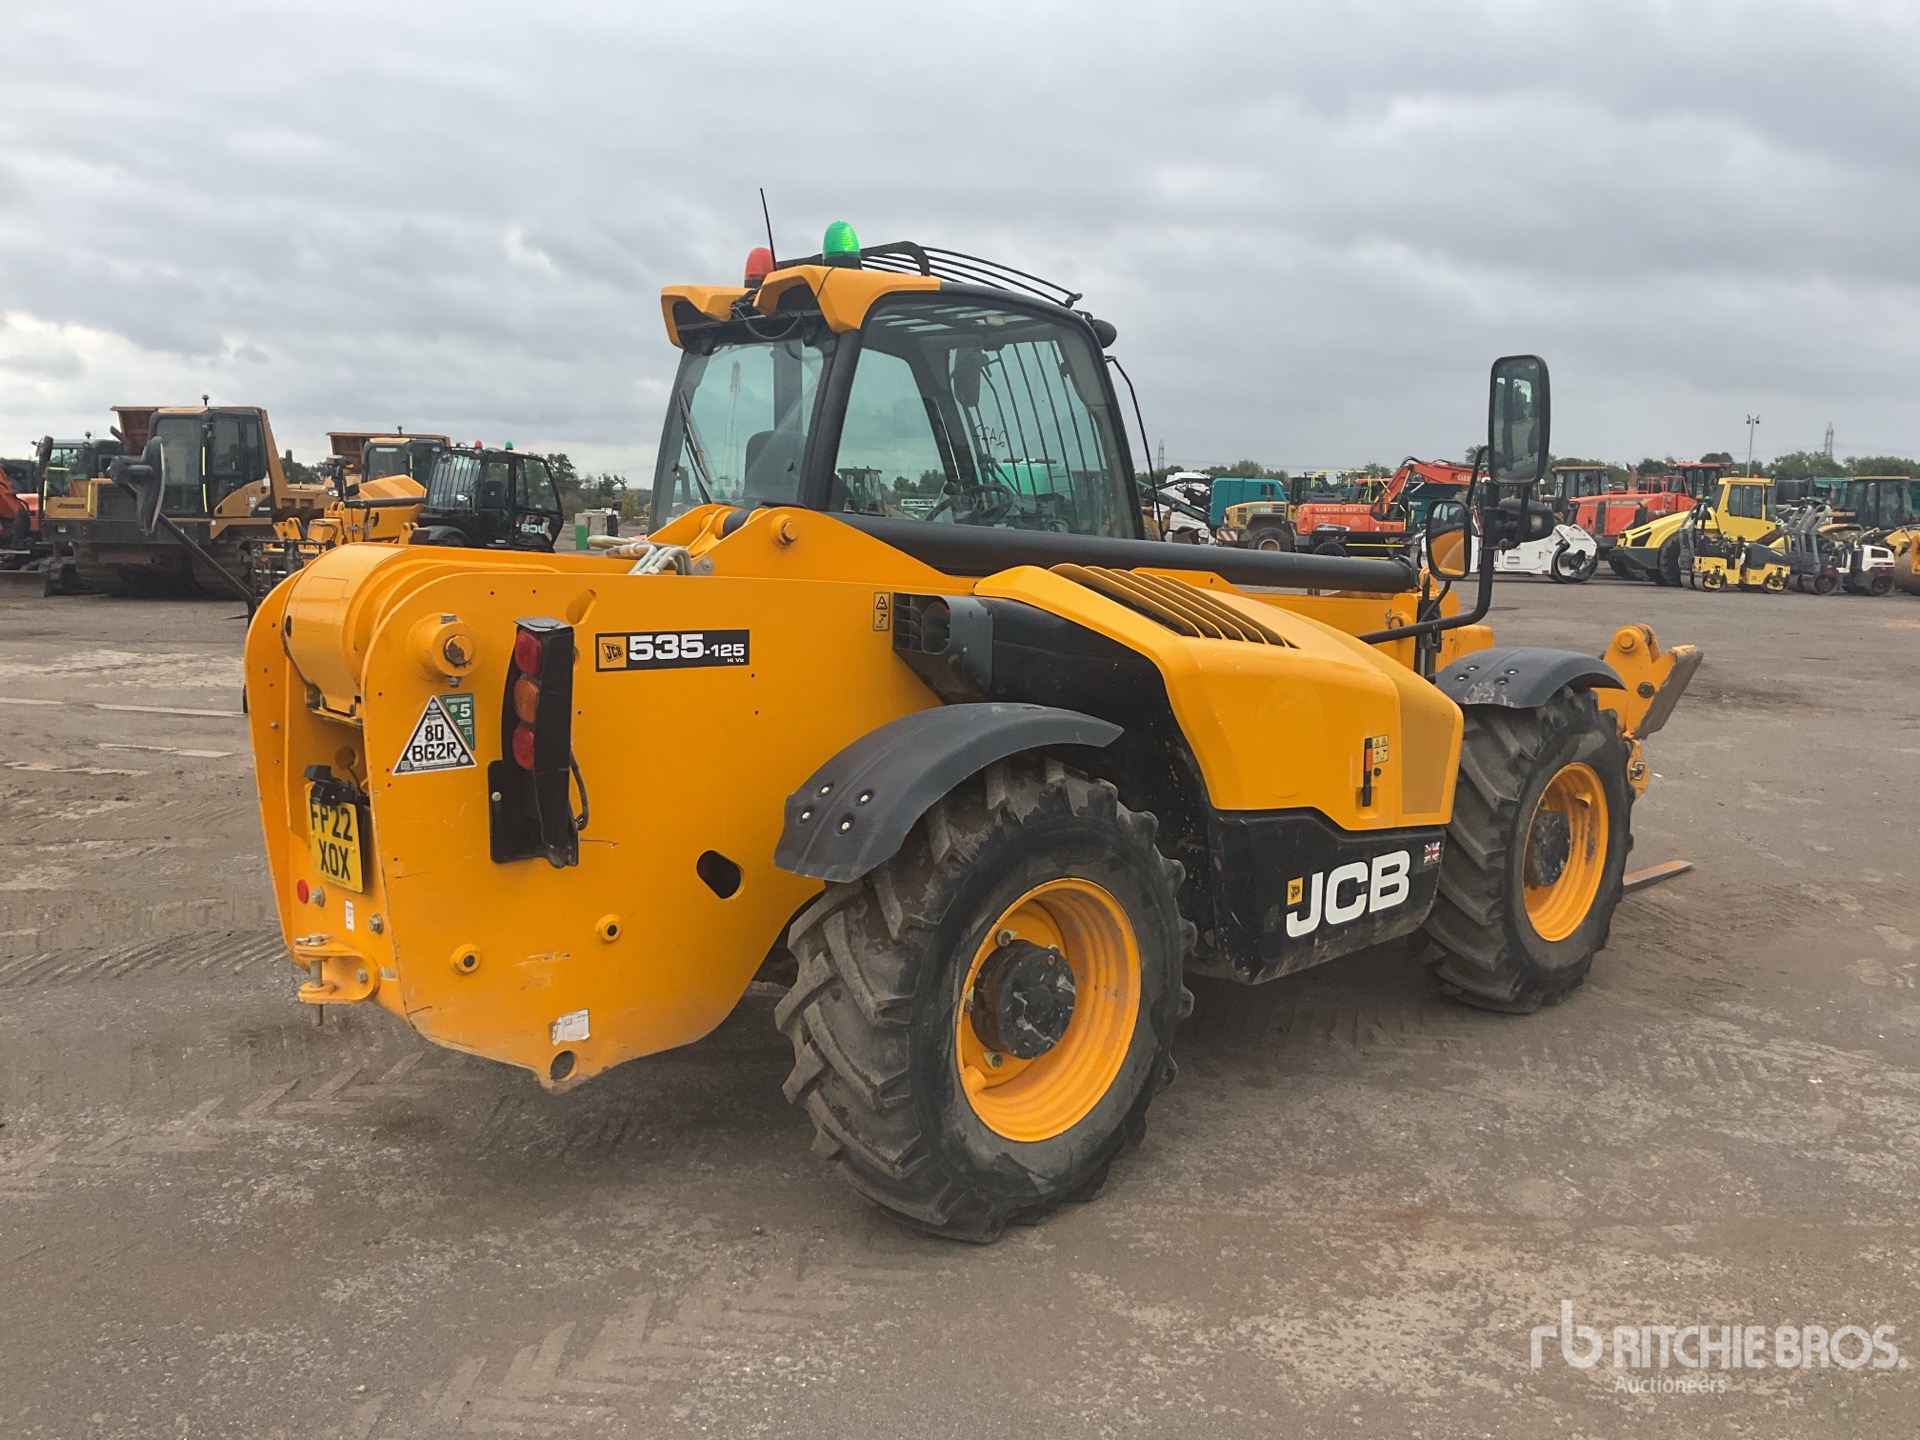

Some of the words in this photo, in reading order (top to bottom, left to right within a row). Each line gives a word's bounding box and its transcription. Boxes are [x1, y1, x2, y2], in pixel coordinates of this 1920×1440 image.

[602, 643, 623, 662] JCB
[459, 703, 471, 718] 5
[412, 741, 457, 762] BG2R
[310, 802, 353, 842] FP22
[318, 839, 351, 881] XOX
[1286, 850, 1410, 938] JCB
